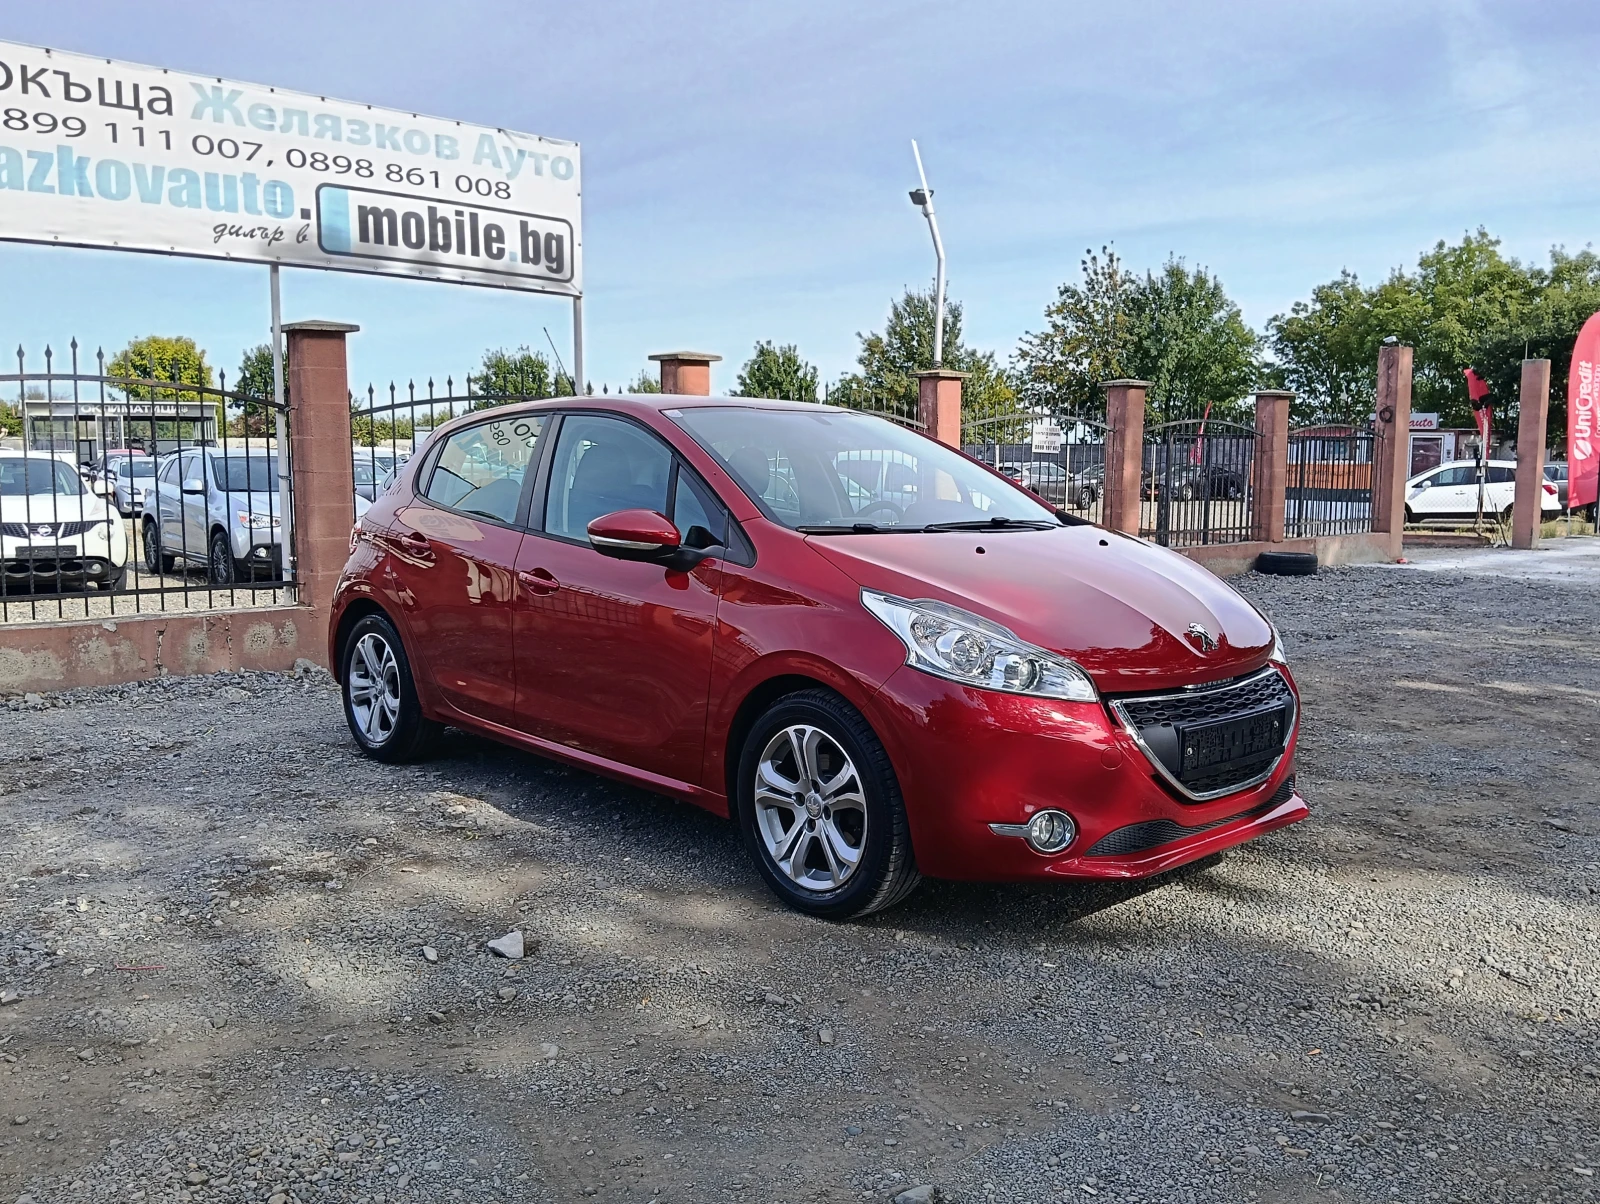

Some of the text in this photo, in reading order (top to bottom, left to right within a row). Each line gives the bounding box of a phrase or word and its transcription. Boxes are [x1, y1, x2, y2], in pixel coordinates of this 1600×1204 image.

[105, 122, 171, 150] 111
[192, 135, 273, 167] 007,
[286, 148, 374, 178] 0898
[385, 163, 439, 189] 861
[455, 174, 512, 200] 008
[189, 82, 461, 160] Желязков
[472, 133, 575, 181] Ауто
[296, 223, 310, 244] в
[358, 205, 565, 274] mobile.bg
[1575, 360, 1592, 438] UniCredit
